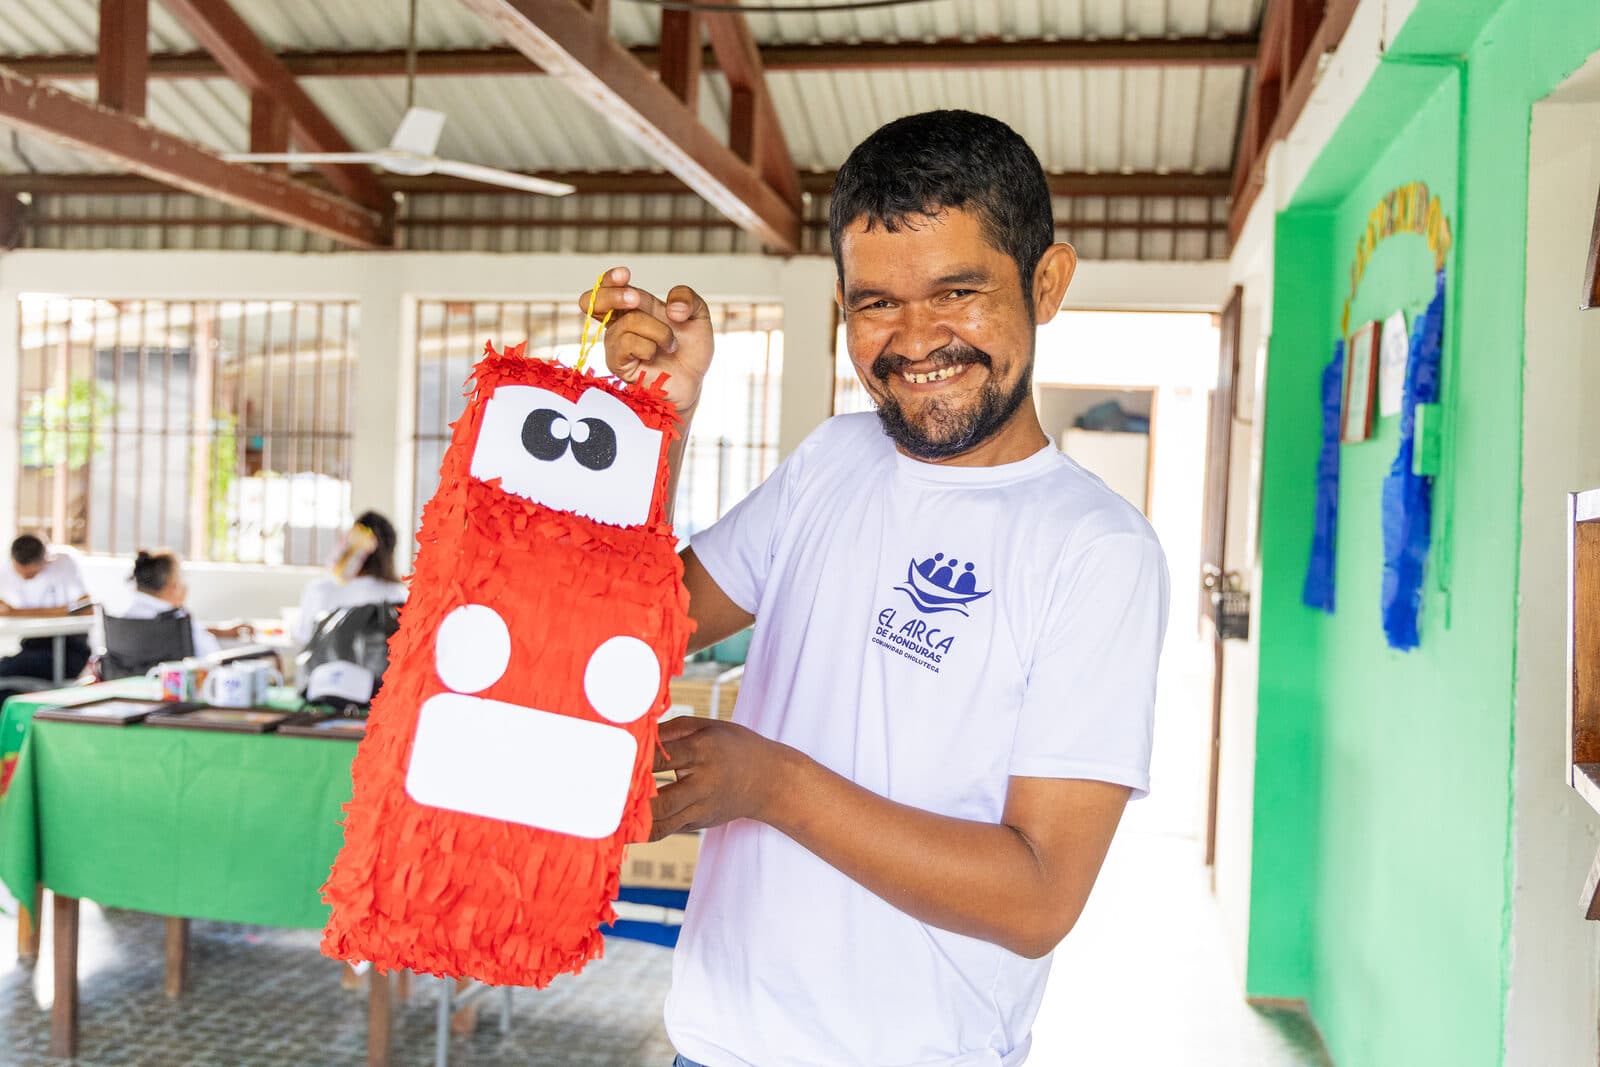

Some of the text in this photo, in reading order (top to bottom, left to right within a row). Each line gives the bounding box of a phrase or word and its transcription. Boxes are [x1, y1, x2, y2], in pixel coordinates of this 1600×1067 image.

[875, 626, 942, 663] DE HONDURAS
[878, 608, 955, 655] EL ARCA
[871, 637, 940, 673] COMUNIDAD CHOLUTECA
